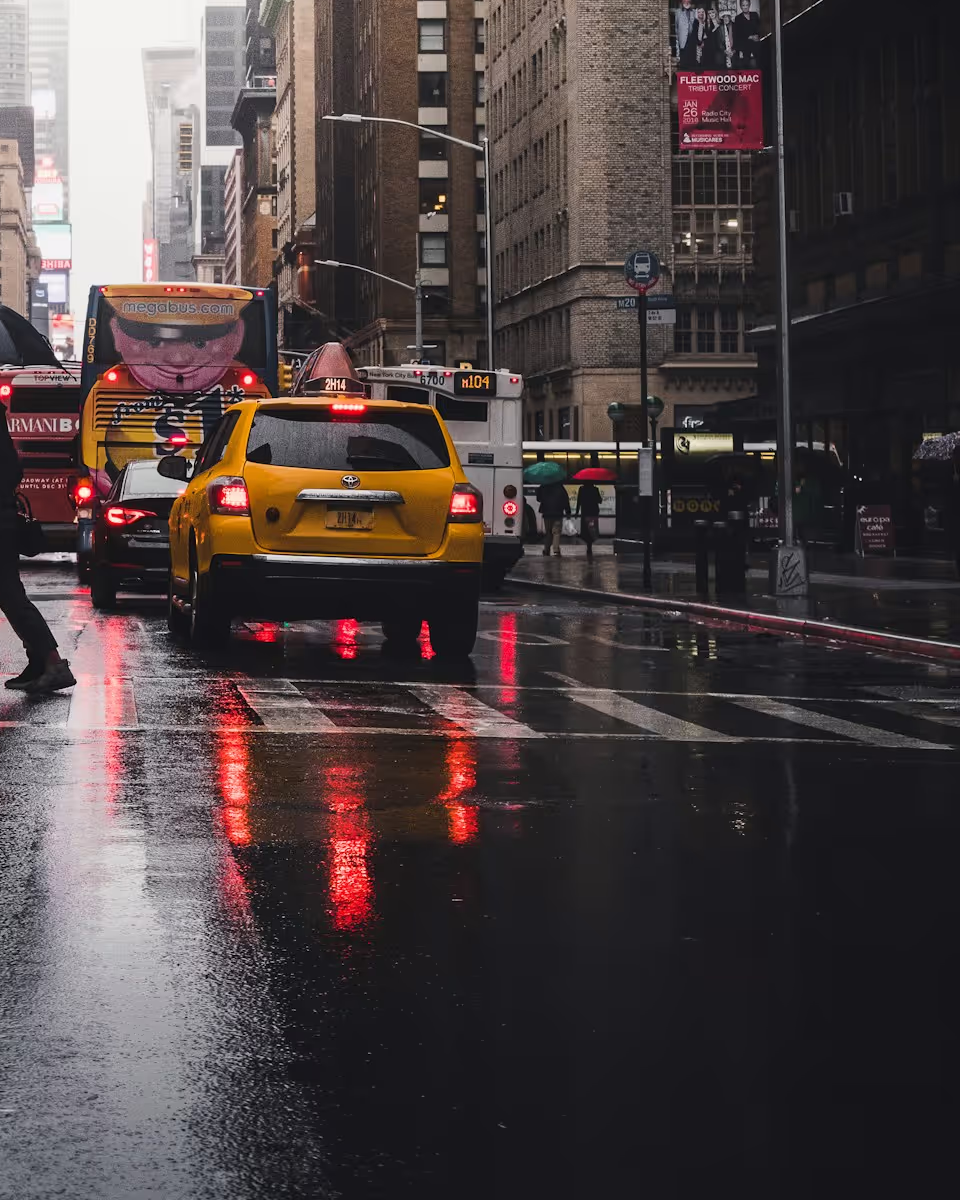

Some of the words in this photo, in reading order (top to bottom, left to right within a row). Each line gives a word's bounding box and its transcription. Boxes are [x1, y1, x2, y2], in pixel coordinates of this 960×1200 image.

[680, 75, 737, 84] FLEETWOOD
[738, 74, 759, 83] MAC
[683, 100, 698, 108] JAN
[683, 107, 698, 117] 26
[123, 301, 235, 315] megabus.com
[618, 298, 636, 307] M20
[87, 317, 97, 364] DD769
[325, 378, 346, 391] 2H14
[420, 375, 445, 386] 6700
[462, 375, 490, 389] M104
